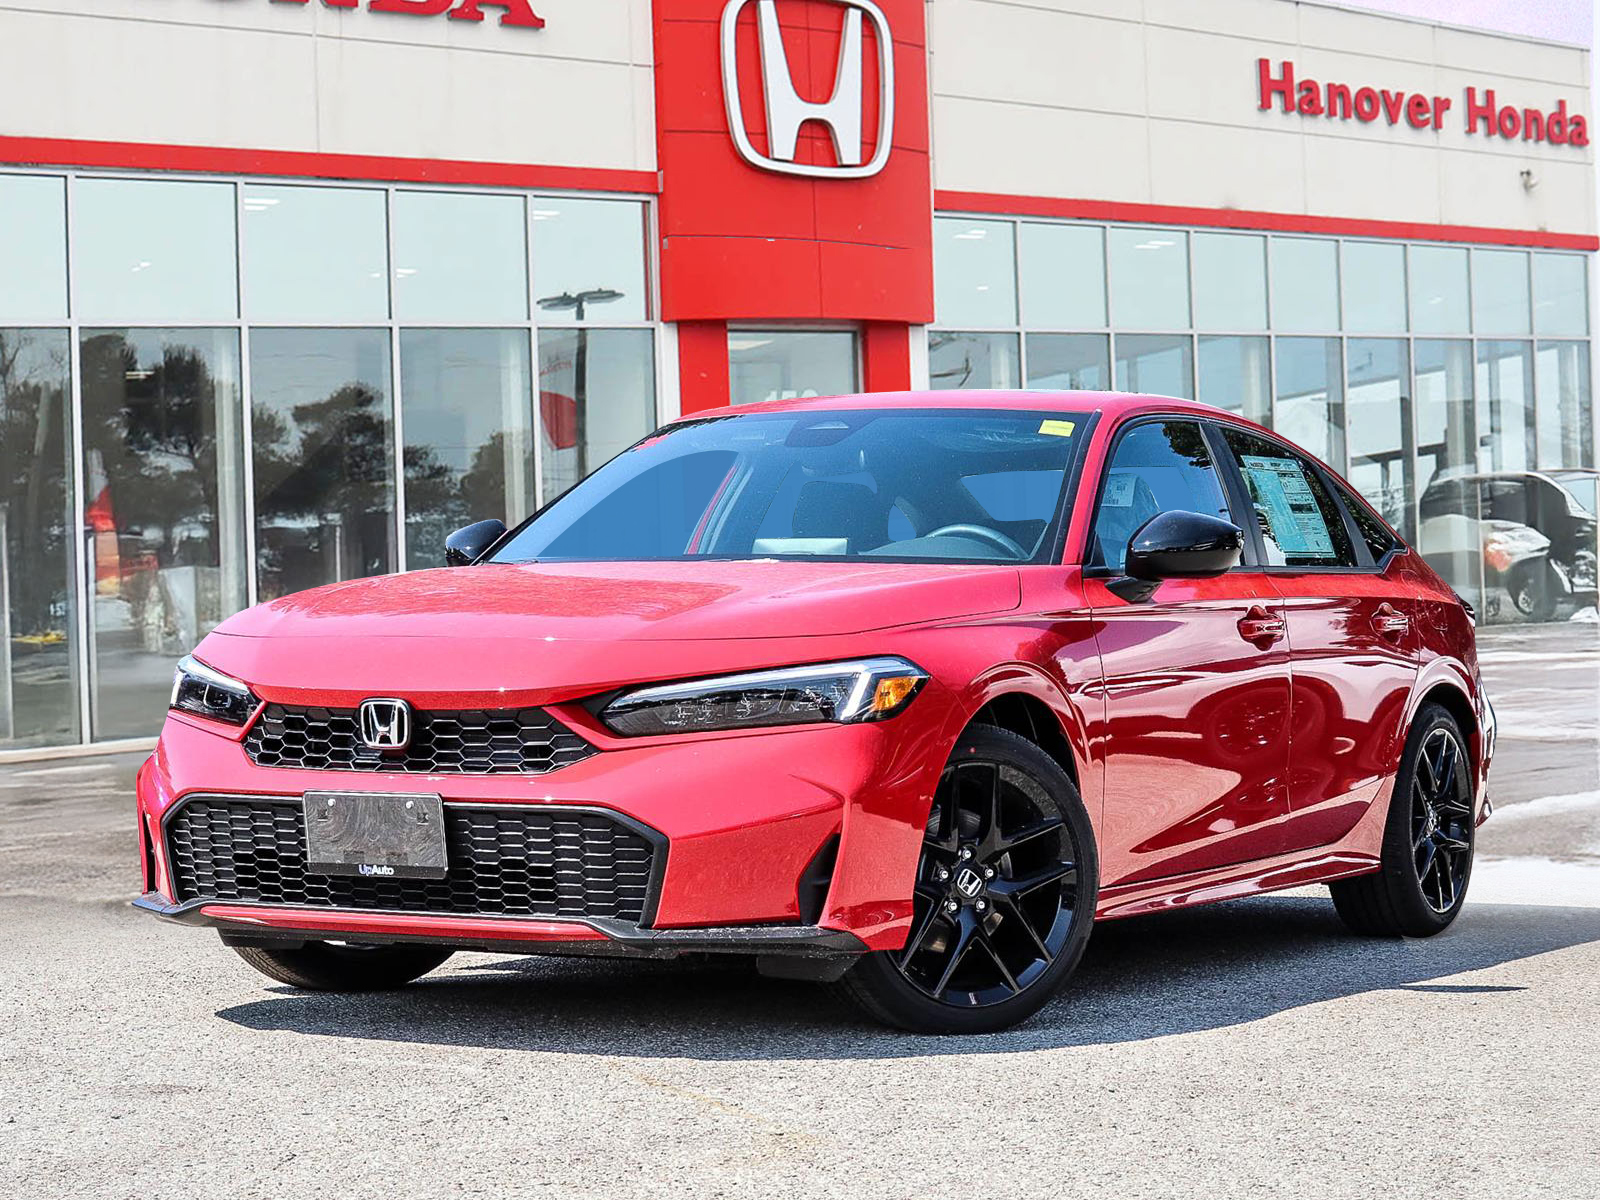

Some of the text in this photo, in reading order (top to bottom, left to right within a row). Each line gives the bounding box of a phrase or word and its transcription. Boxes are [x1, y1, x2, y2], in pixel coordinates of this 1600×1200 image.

[1257, 57, 1590, 147] Hanover Honda
[358, 864, 395, 877] UpAuto
